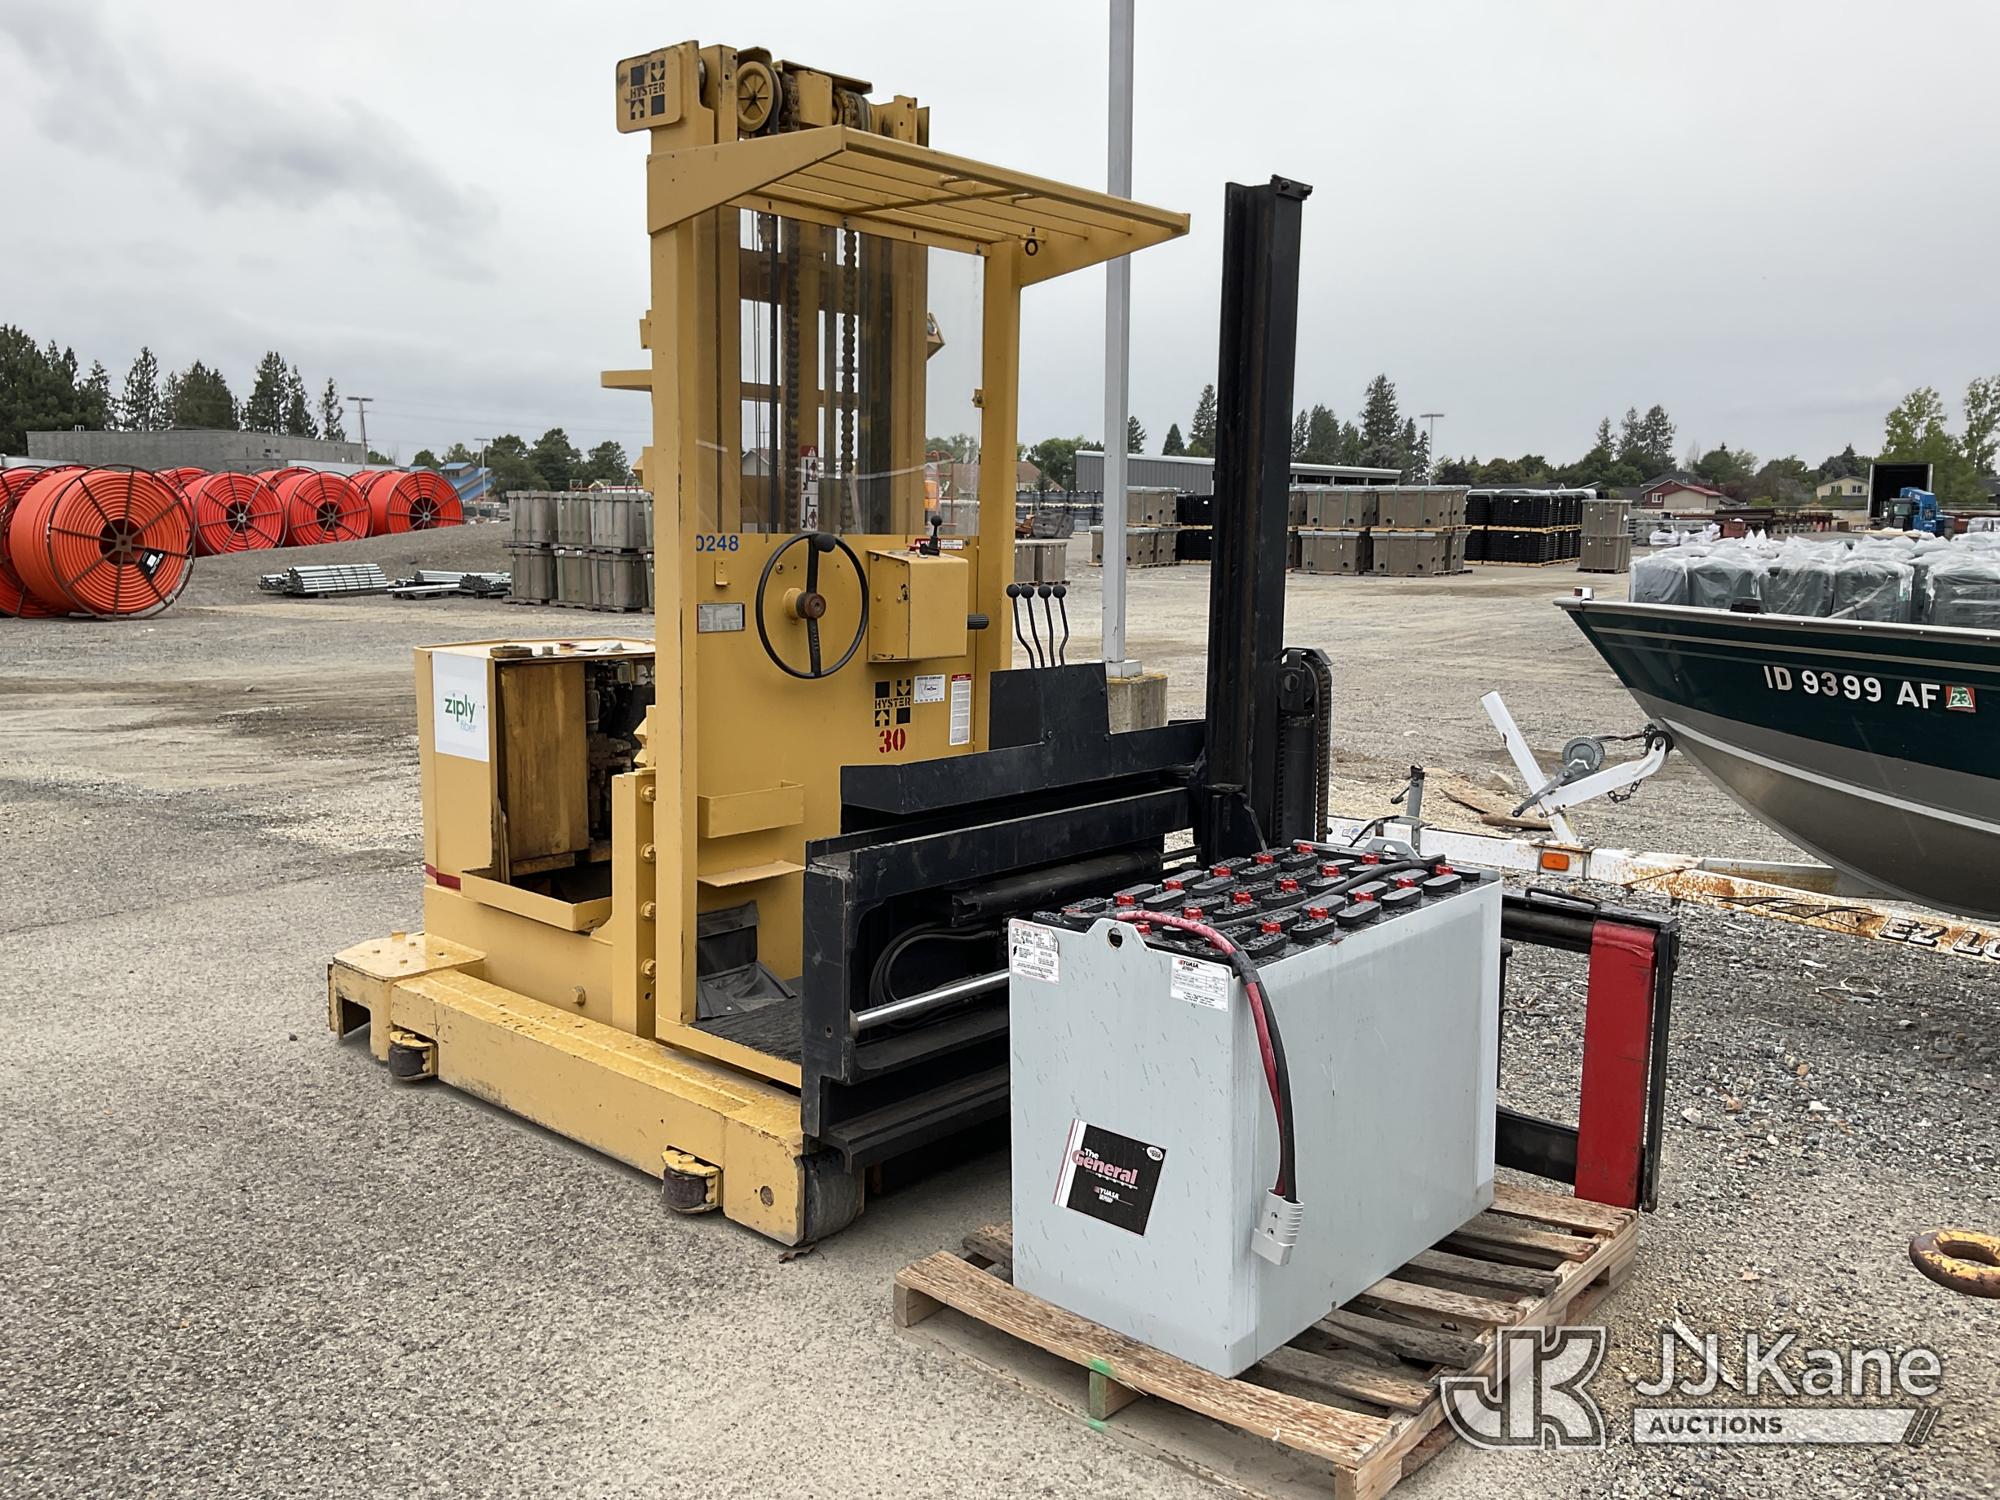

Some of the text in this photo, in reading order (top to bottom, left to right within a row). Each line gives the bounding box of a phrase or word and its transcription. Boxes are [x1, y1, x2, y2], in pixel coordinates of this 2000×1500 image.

[630, 82, 665, 99] HYSTER
[1763, 665, 1941, 709] ID 9399 AF
[444, 693, 476, 723] ziply
[875, 697, 911, 710] HYSTER
[1952, 693, 1970, 705] 23
[879, 728, 906, 754] 30
[1084, 1147, 1100, 1160] The
[1072, 1149, 1138, 1185] General
